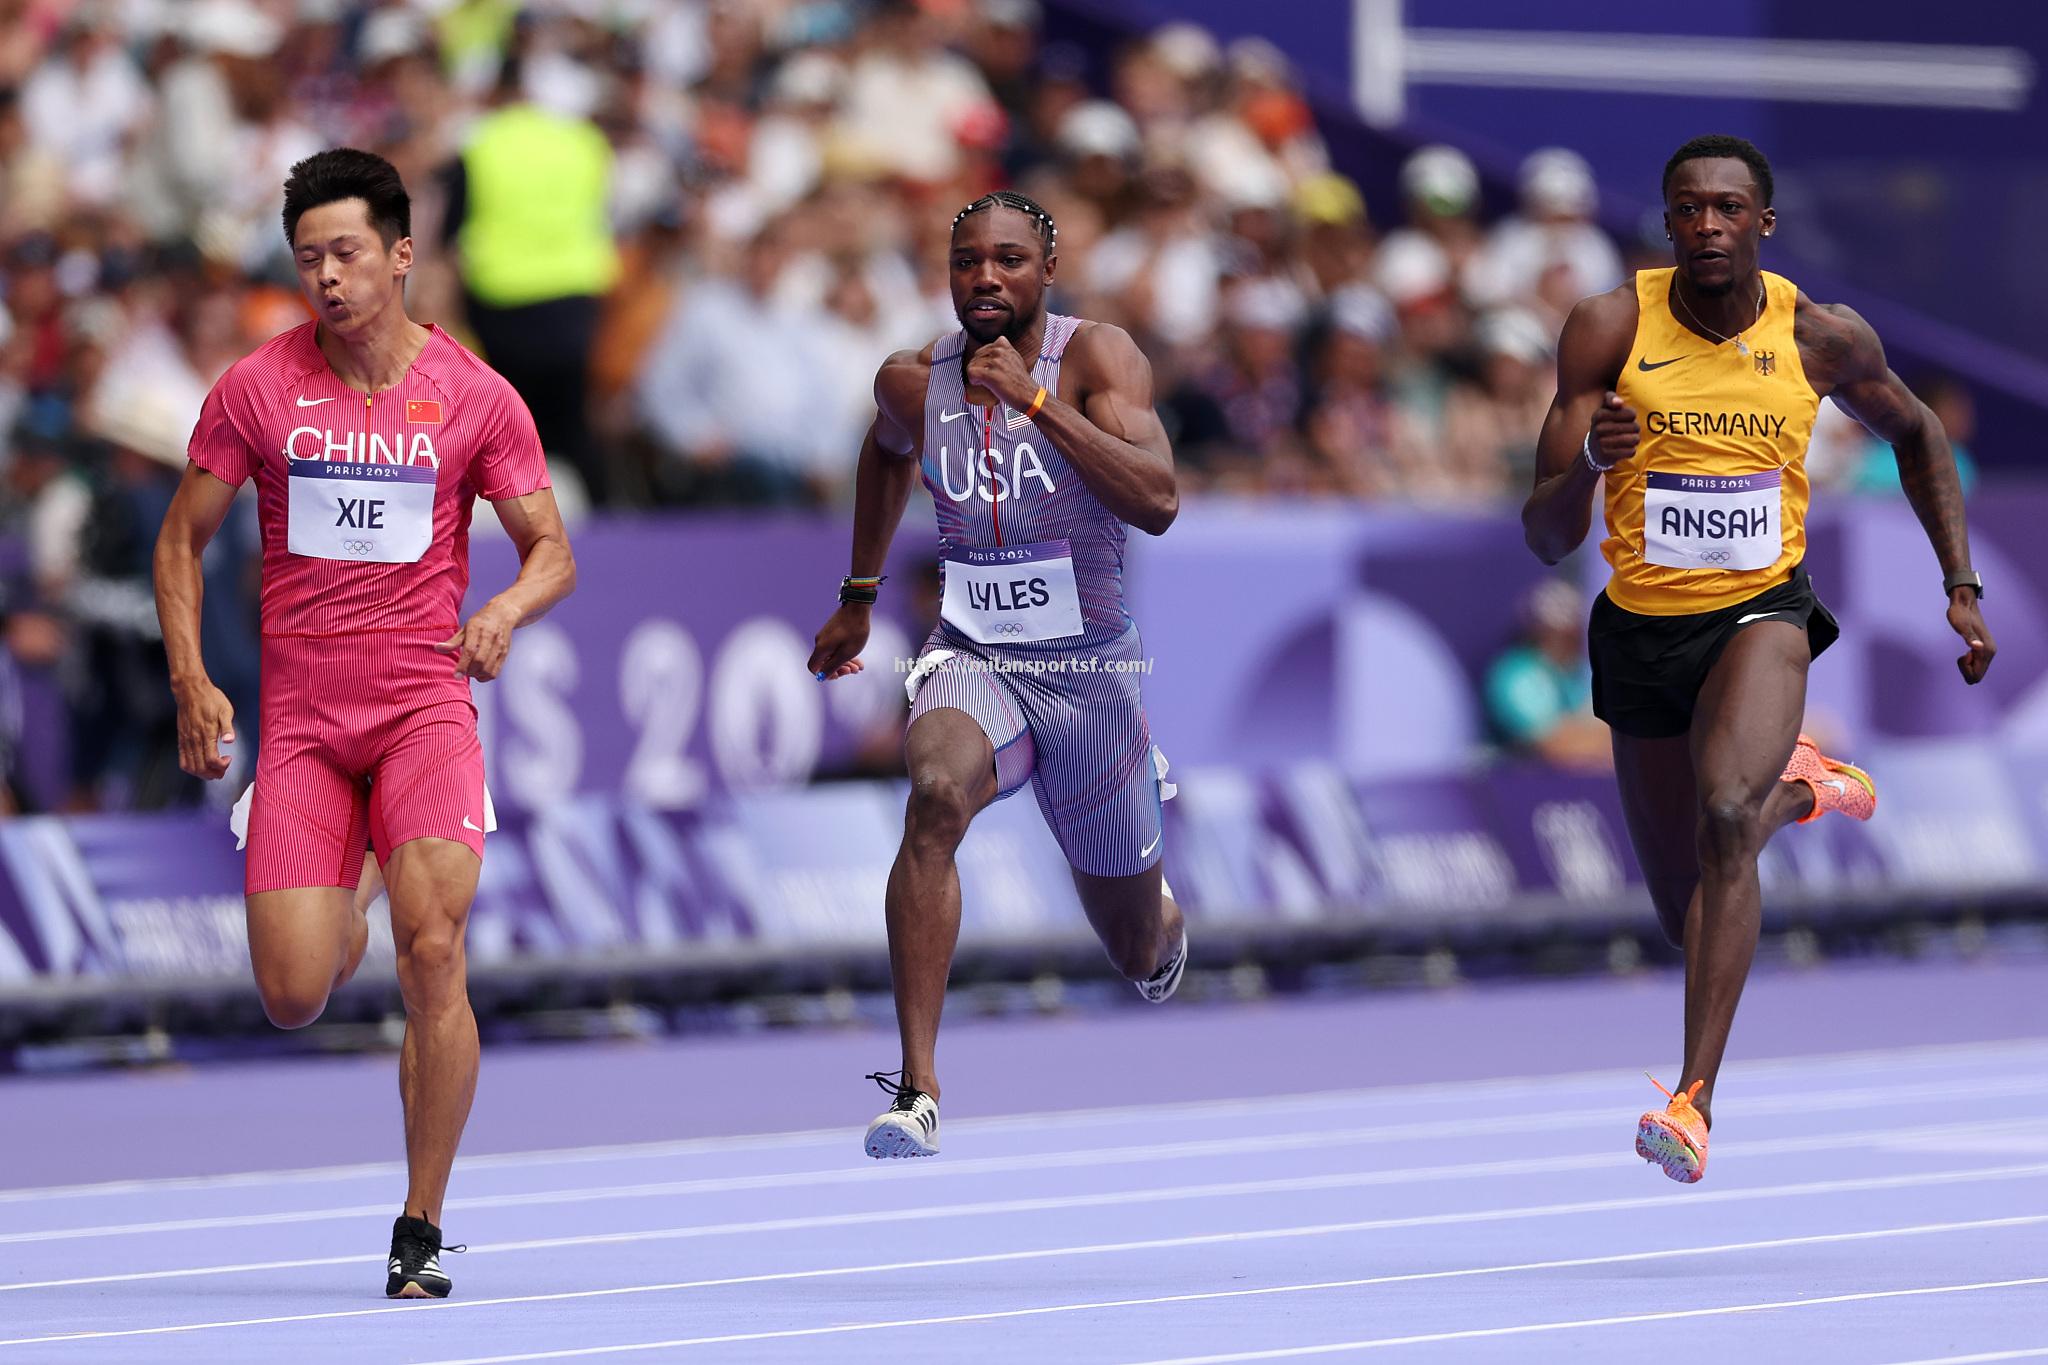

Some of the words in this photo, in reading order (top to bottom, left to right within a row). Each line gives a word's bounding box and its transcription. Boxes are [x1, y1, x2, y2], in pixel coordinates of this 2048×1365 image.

[1646, 411, 1787, 439] GERMANY
[286, 426, 440, 469] CHINA
[366, 467, 399, 477] 2024
[940, 442, 1056, 503] USA
[1720, 479, 1751, 489] 2024
[335, 497, 386, 530] XIE
[1661, 505, 1768, 539] ANSAH
[999, 550, 1032, 561] 2024
[966, 577, 1050, 611] LYLES
